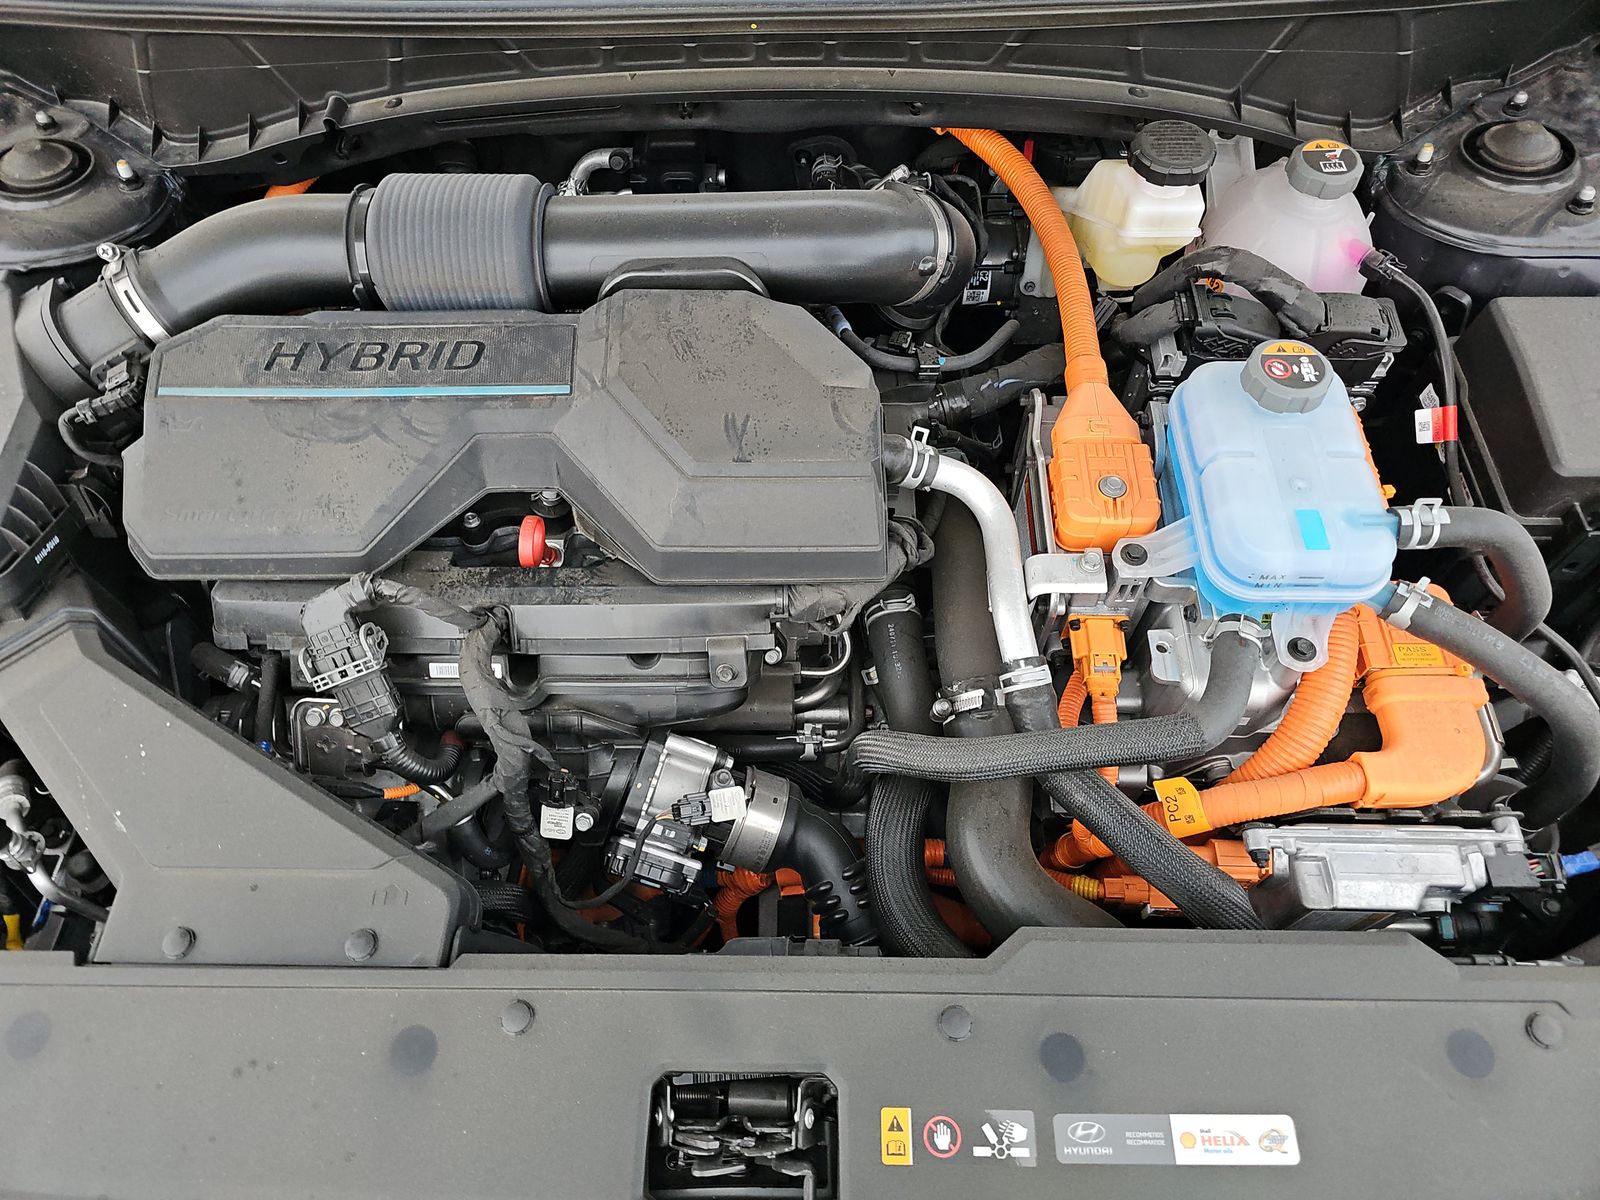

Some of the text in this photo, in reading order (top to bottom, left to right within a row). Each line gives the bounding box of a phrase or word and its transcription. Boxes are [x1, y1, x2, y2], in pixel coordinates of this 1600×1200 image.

[263, 340, 487, 372] HYBRID
[1164, 794, 1182, 823] PC2
[1201, 1135, 1250, 1146] HELIX
[1063, 1146, 1113, 1156] HYUNDAI
